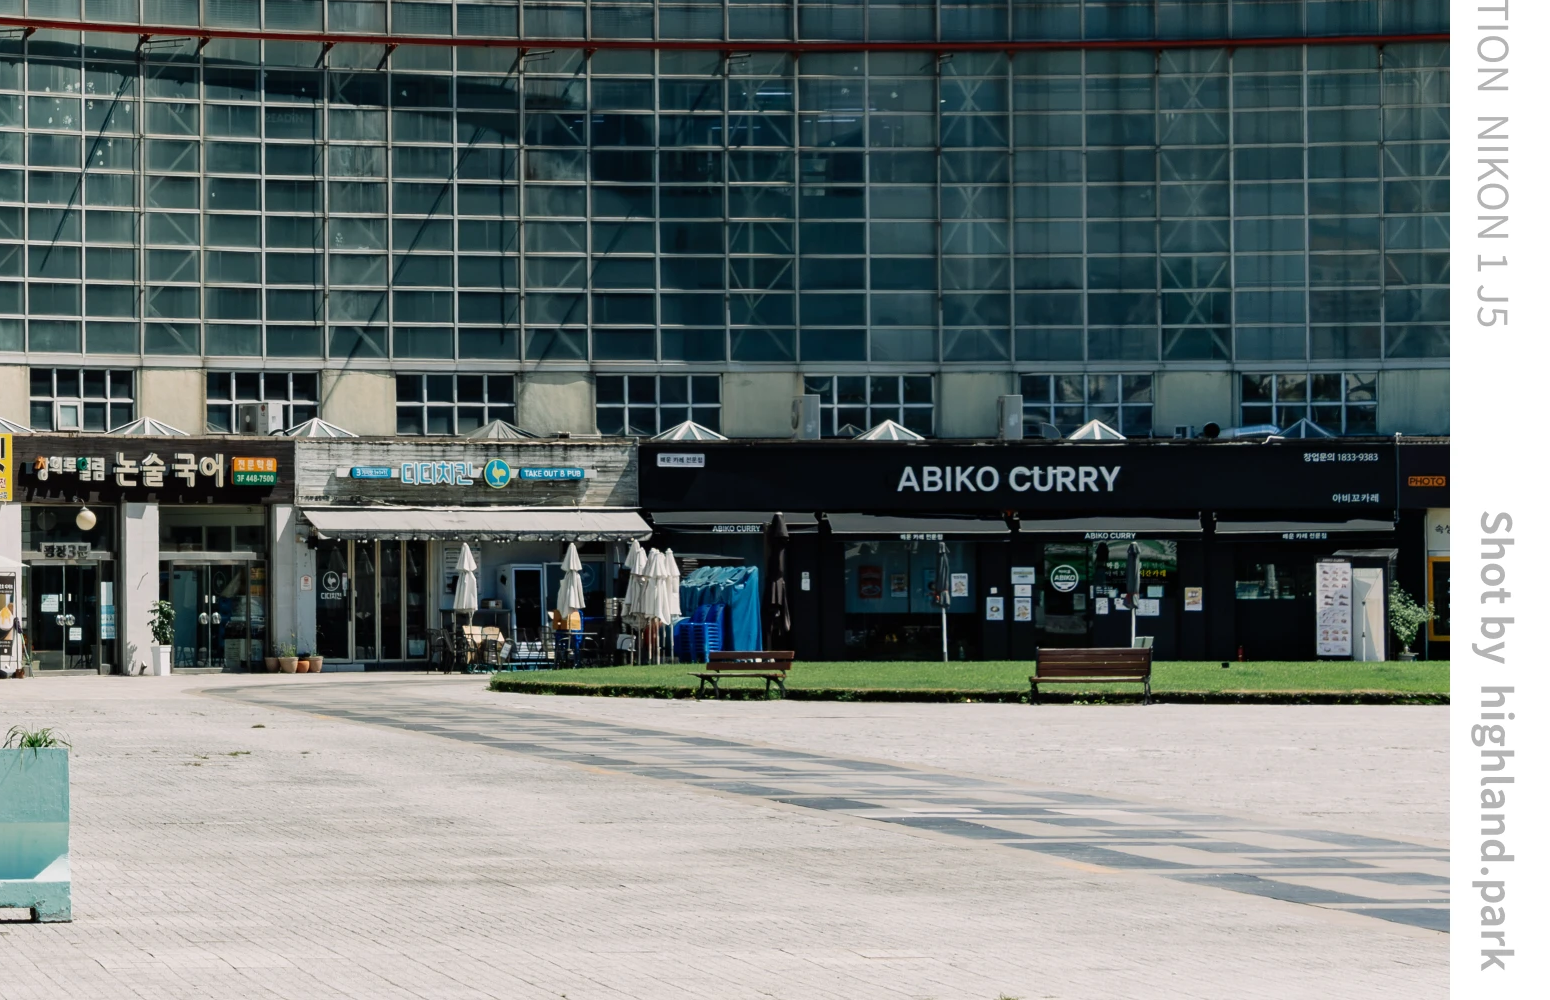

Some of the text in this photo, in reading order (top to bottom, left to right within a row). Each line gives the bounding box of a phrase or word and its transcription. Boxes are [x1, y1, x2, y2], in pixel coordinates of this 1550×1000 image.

[1303, 453, 1379, 462] 창업문의 1833-9383
[113, 452, 166, 487] 논술
[172, 453, 224, 487] 국어
[237, 460, 274, 471] 전문학원
[401, 460, 474, 485] 디디치킨
[246, 475, 275, 483] 448-7500
[897, 466, 1121, 492] ABIKO CURRY
[1409, 477, 1445, 486] PHOTO
[1332, 493, 1380, 503] 아비꼬카레
